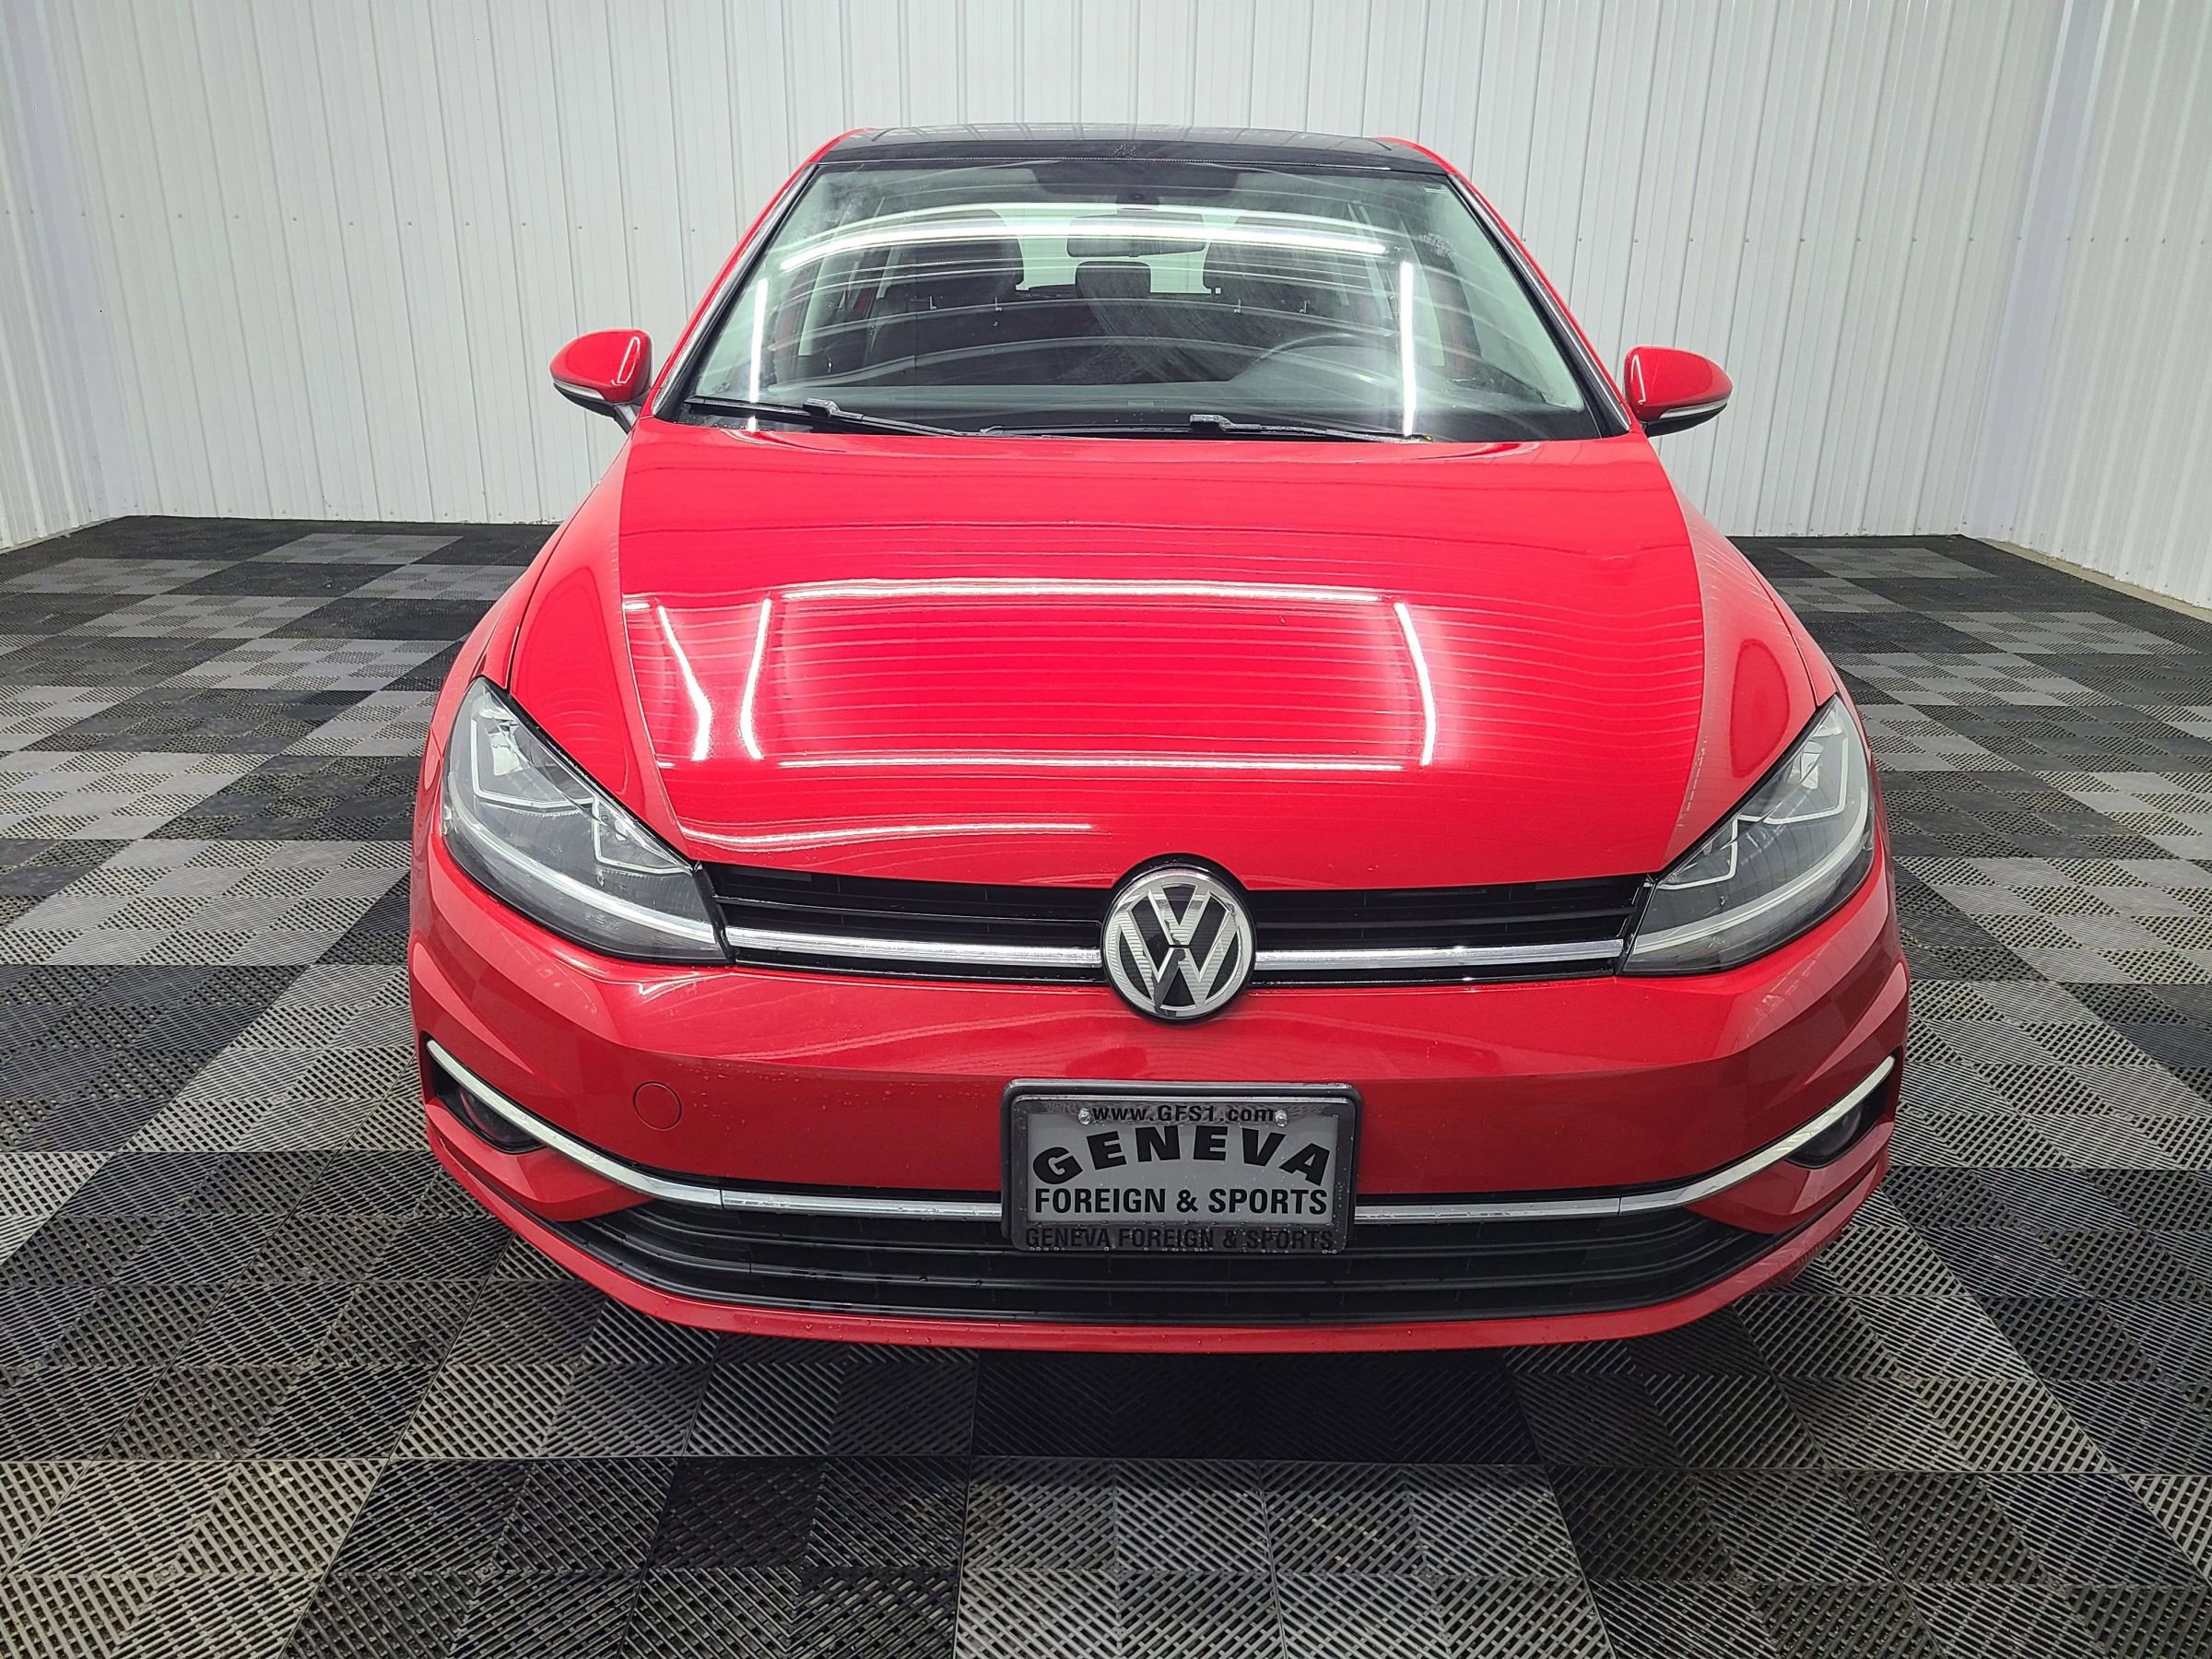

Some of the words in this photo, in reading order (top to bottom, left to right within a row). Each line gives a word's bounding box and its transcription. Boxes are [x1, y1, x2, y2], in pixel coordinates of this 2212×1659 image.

[1091, 1105, 1275, 1123] www.GFS1.com
[1032, 1125, 1331, 1186] GENEVA
[1034, 1188, 1166, 1214] FOREIGN
[1176, 1189, 1199, 1214] &
[1208, 1189, 1327, 1215] SPORTS
[1025, 1228, 1109, 1247] GENEVA
[1118, 1229, 1214, 1248] FOREIGN
[1222, 1230, 1238, 1248] &
[1246, 1230, 1333, 1250] SPORTS
